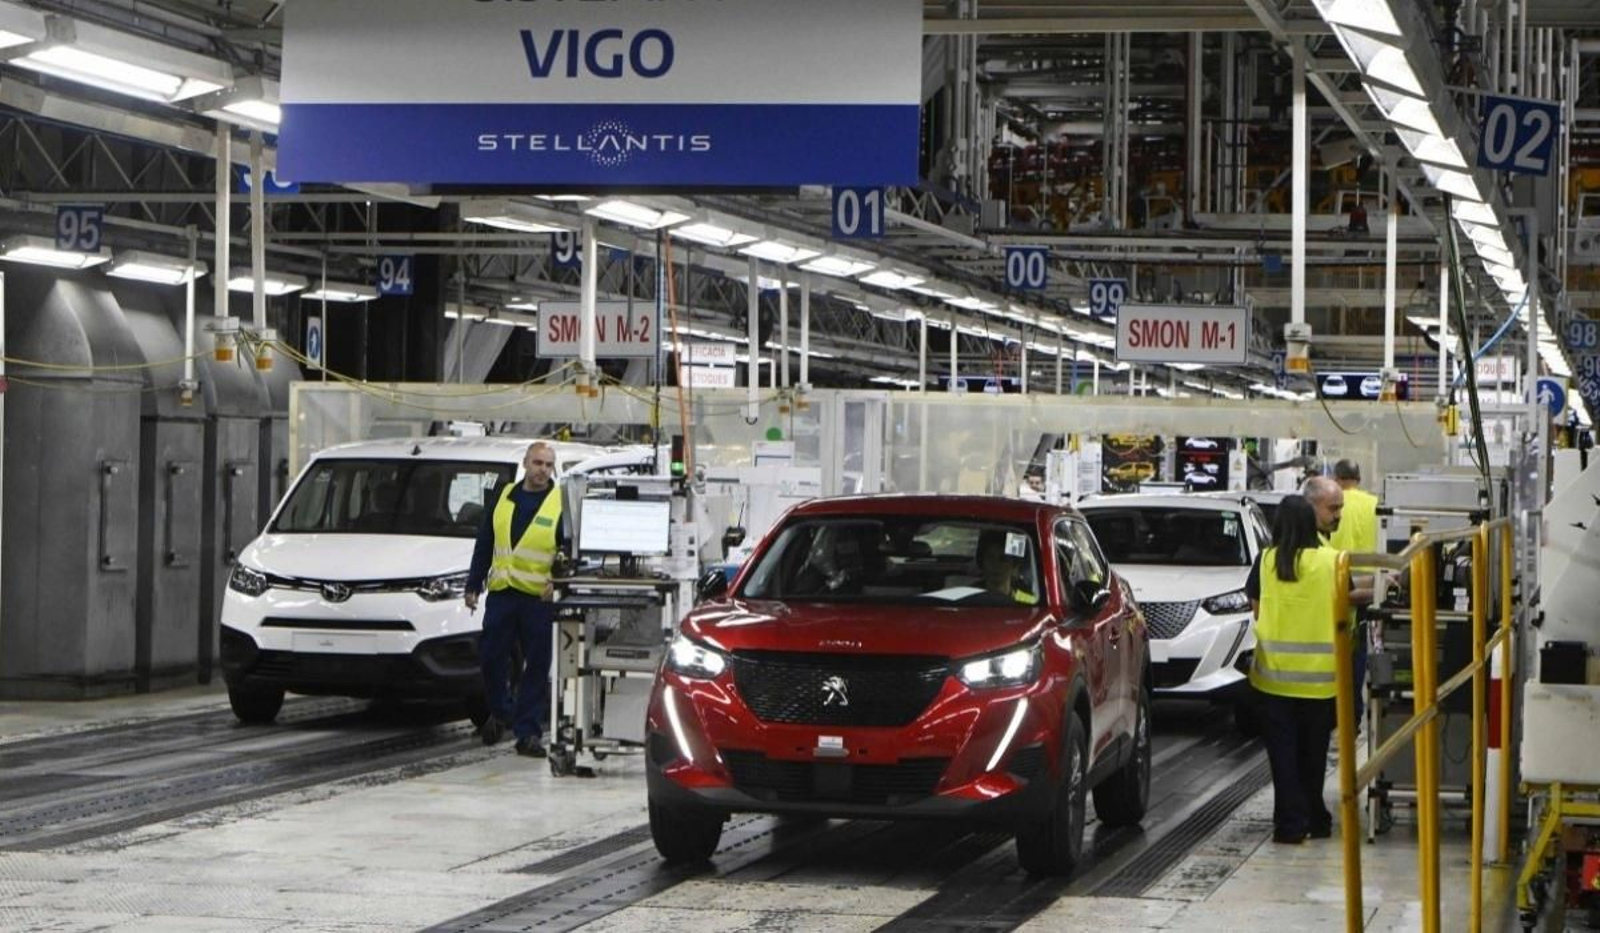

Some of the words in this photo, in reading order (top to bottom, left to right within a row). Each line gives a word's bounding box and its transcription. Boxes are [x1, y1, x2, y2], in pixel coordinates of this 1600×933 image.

[519, 28, 675, 79] VIGO
[477, 134, 711, 151] STELLANTIS
[1484, 103, 1551, 170] 02
[837, 189, 880, 235] 01
[58, 210, 101, 250] 95
[380, 257, 411, 292] 94
[1007, 250, 1045, 288] 00
[1091, 282, 1125, 315] 99
[548, 315, 606, 343] SMN
[616, 315, 651, 343] M-2
[1128, 319, 1190, 349] SMON
[1201, 320, 1236, 350] M-1
[1570, 322, 1597, 347] 98
